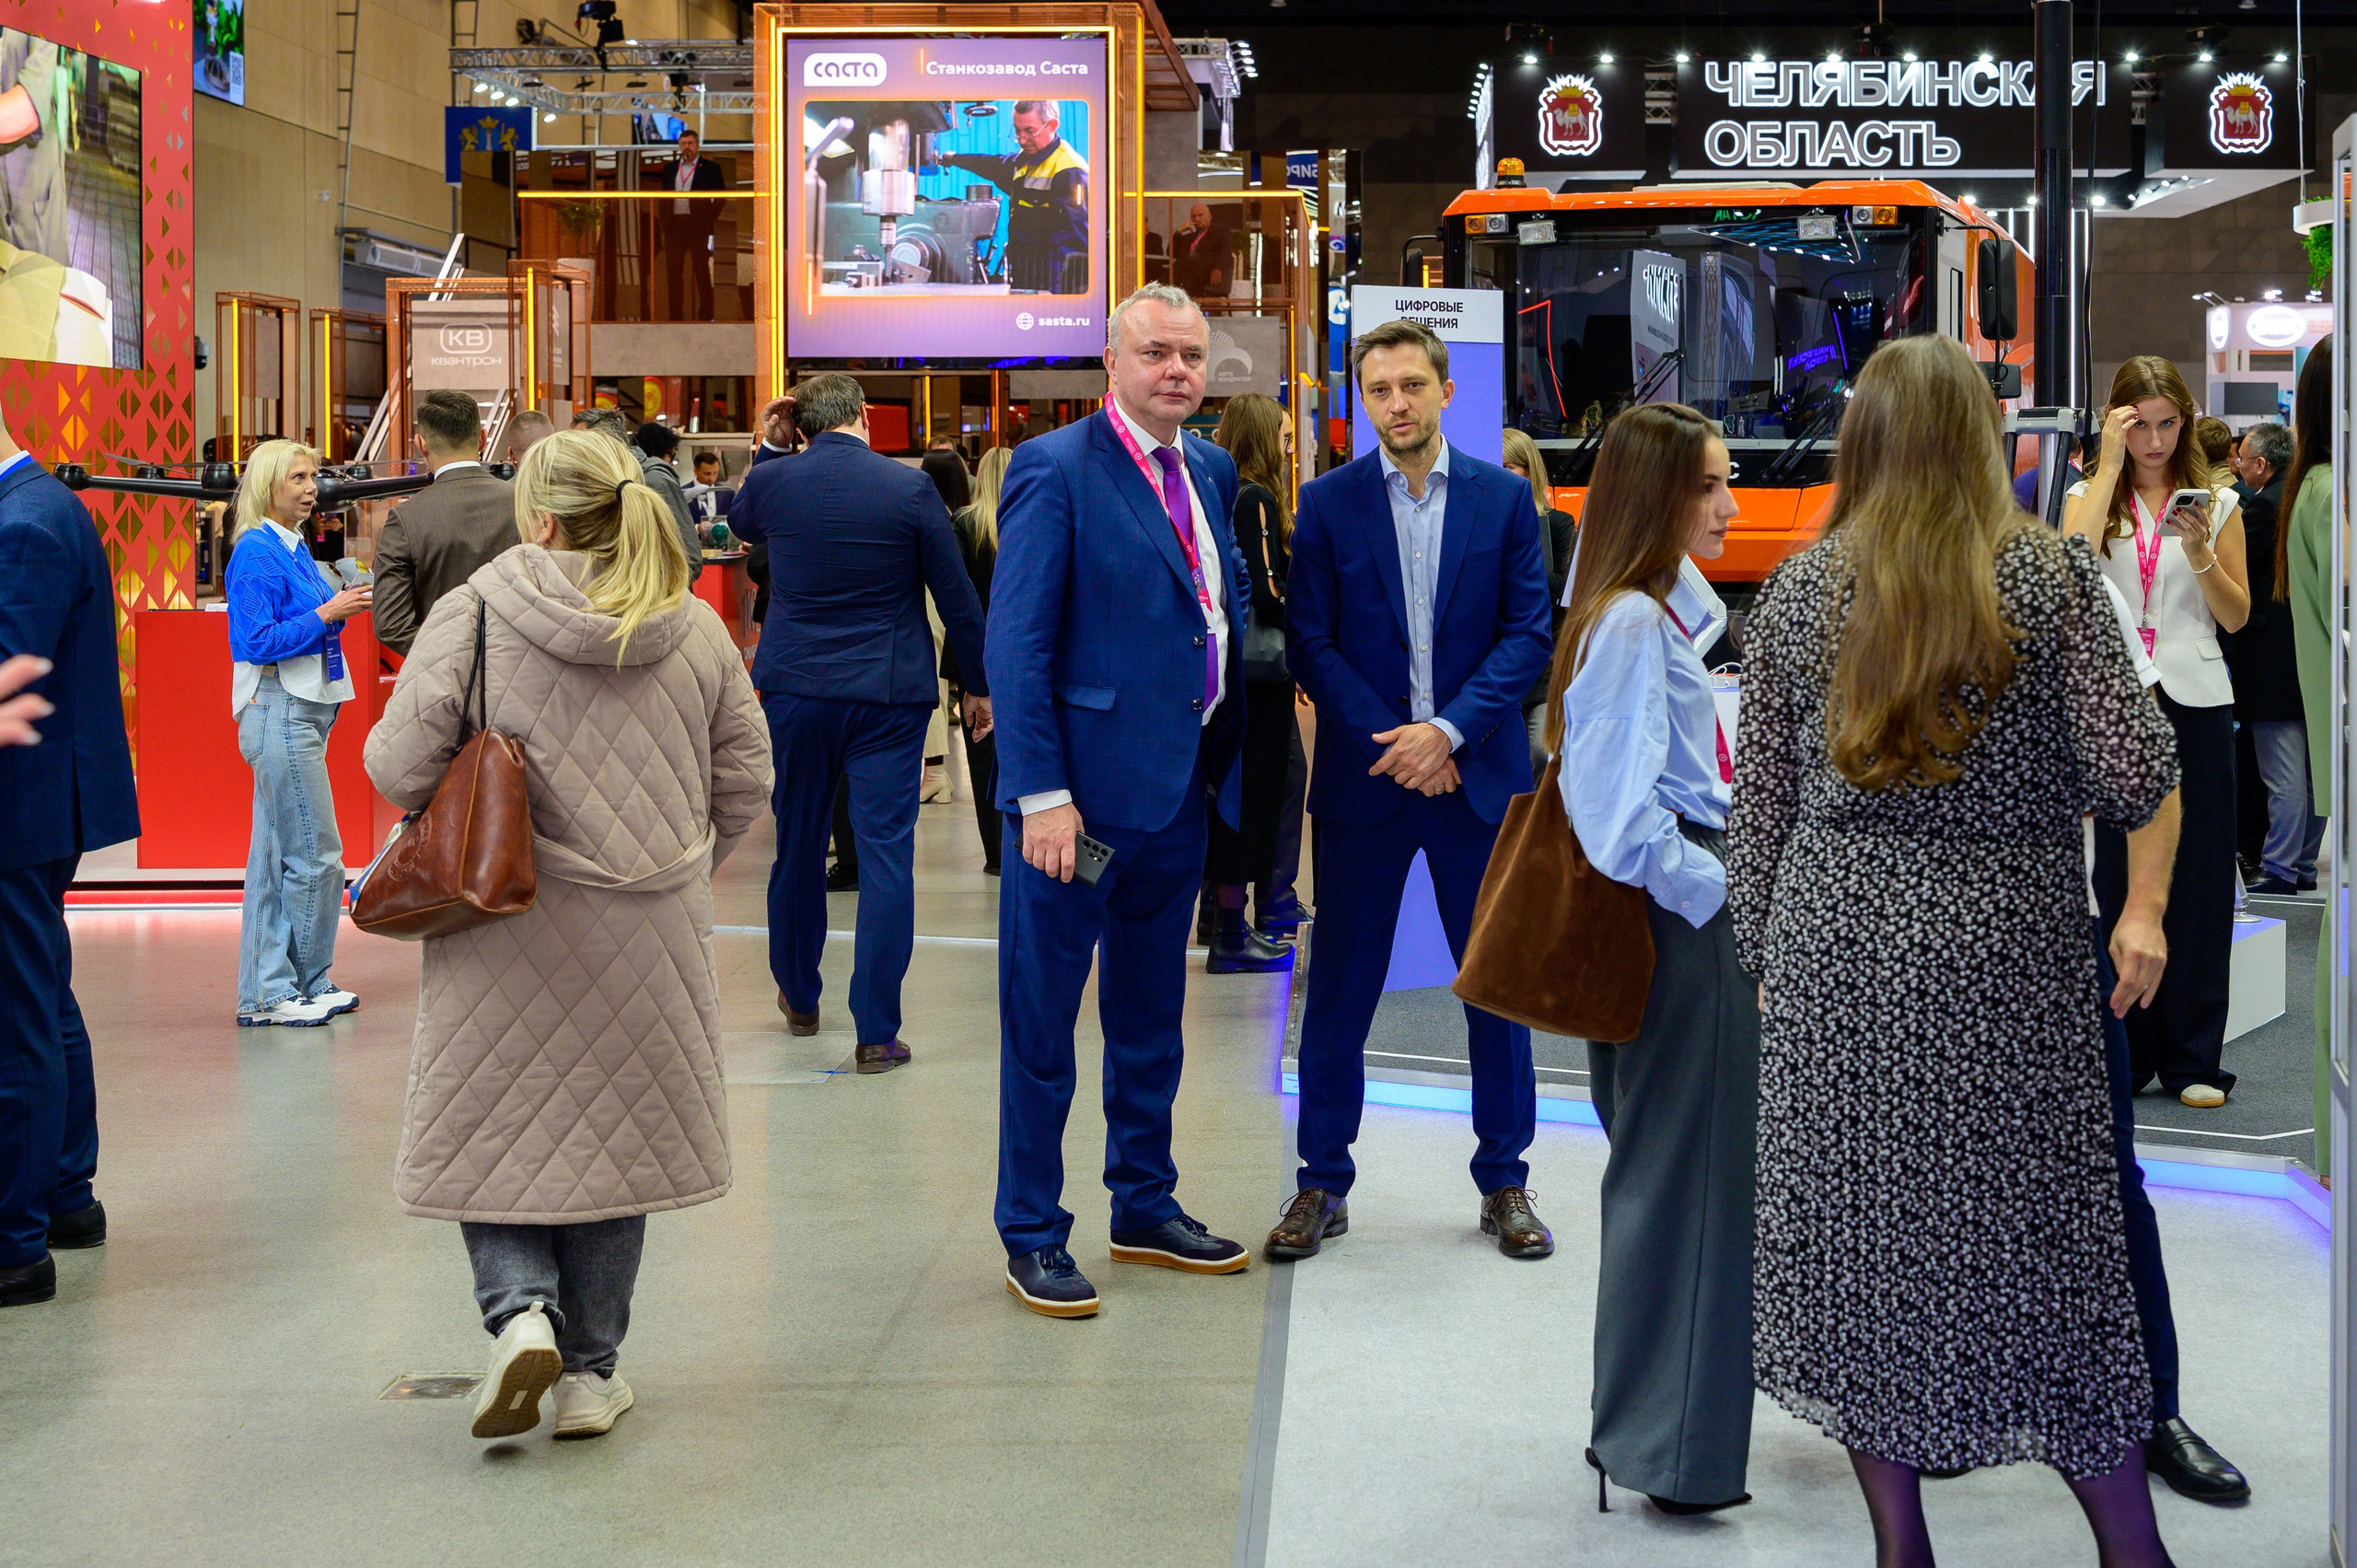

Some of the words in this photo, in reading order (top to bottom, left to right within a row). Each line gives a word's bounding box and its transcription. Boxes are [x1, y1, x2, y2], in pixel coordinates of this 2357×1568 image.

[925, 61, 1037, 76] Станкозавод
[1039, 61, 1088, 75] Саста
[1704, 60, 2106, 108] ЧЕЛЯБИНСКЯ
[1704, 121, 1961, 167] ОБЛАСТЬ
[1395, 299, 1464, 313] ЦИФРОВЫЕ
[1038, 316, 1090, 327] sasta.ru
[1400, 316, 1458, 330] ШЕНИЯ
[447, 330, 485, 347] КВ
